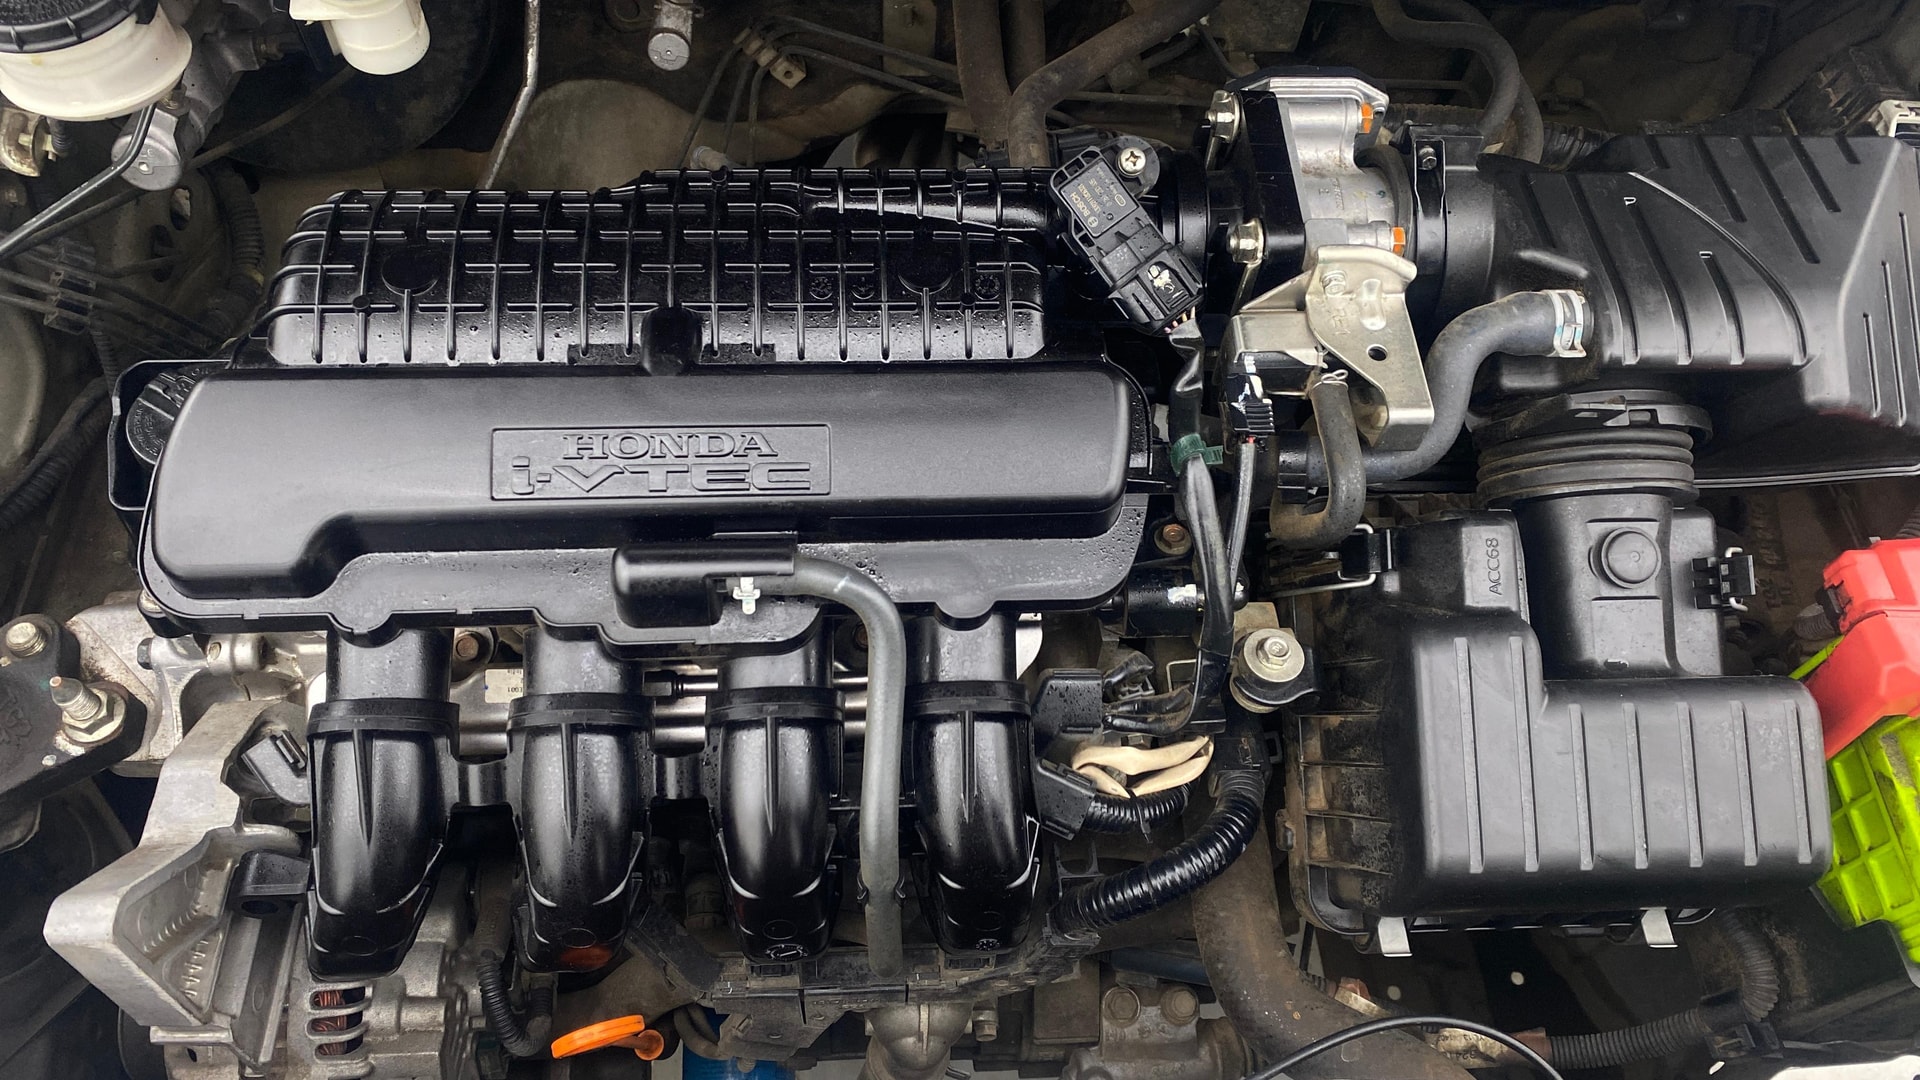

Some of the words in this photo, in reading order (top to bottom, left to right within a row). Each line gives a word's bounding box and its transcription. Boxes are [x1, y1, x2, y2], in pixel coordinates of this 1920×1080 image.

[1070, 191, 1091, 217] BOSCH
[562, 431, 778, 460] HONDA
[511, 455, 811, 495] i-VTEC
[485, 537, 503, 596] ACC68
